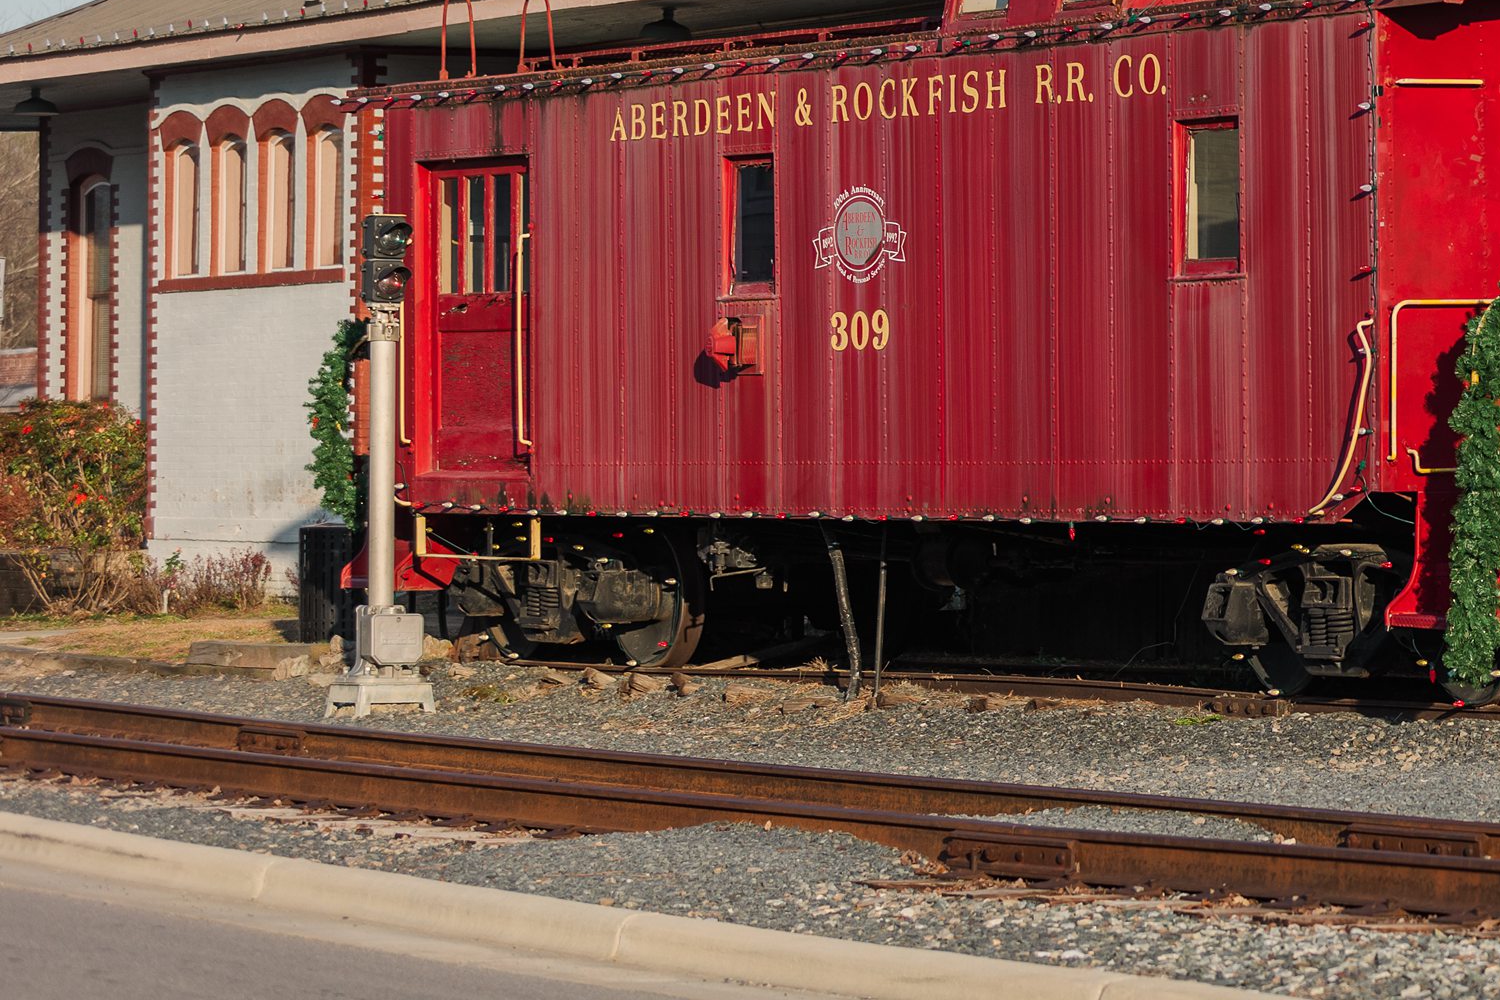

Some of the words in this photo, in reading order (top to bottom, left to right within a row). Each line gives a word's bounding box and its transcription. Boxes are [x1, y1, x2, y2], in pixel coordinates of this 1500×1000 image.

[609, 91, 776, 142] ABERDEEN
[794, 87, 813, 127] &
[830, 69, 1006, 123] ROCKFISH
[1035, 62, 1094, 104] R.R.
[1113, 53, 1167, 98] CO.
[834, 190, 849, 209] 100th
[850, 184, 884, 207] Anniversary
[822, 236, 834, 249] 1892
[886, 232, 897, 244] 1992
[830, 309, 890, 351] 309
